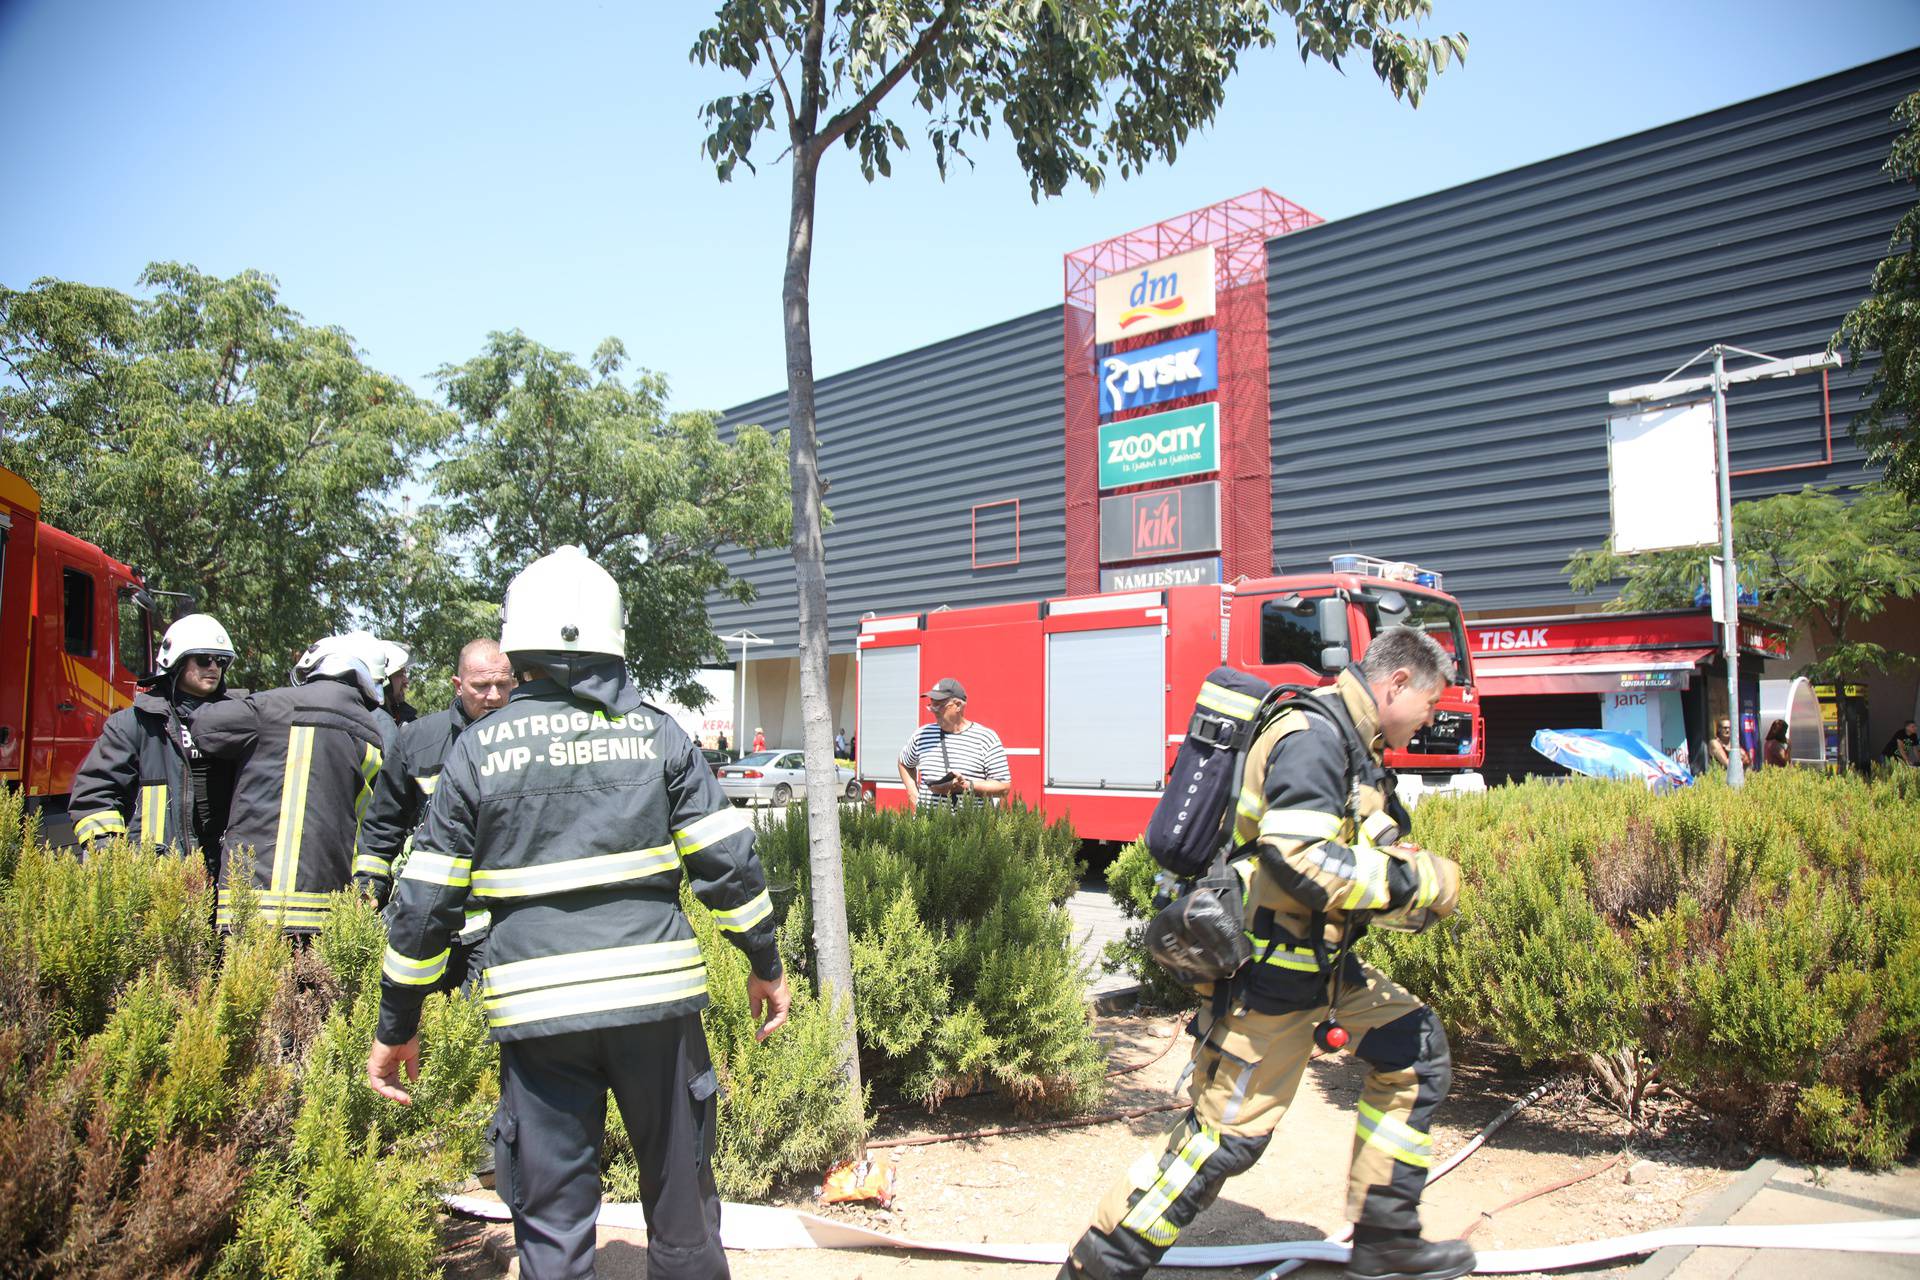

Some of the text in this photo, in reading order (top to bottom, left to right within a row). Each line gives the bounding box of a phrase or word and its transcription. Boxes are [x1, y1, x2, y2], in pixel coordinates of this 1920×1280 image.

[1130, 270, 1178, 307] dm
[1123, 348, 1202, 393] JYSK
[1107, 423, 1206, 464] ZOOCITY
[1137, 496, 1177, 549] kik
[1114, 567, 1201, 590] NAMJEŠTAJ
[1479, 628, 1548, 650] TISAK
[548, 736, 657, 767] ŠIBENIK
[1173, 757, 1208, 834] VODICE
